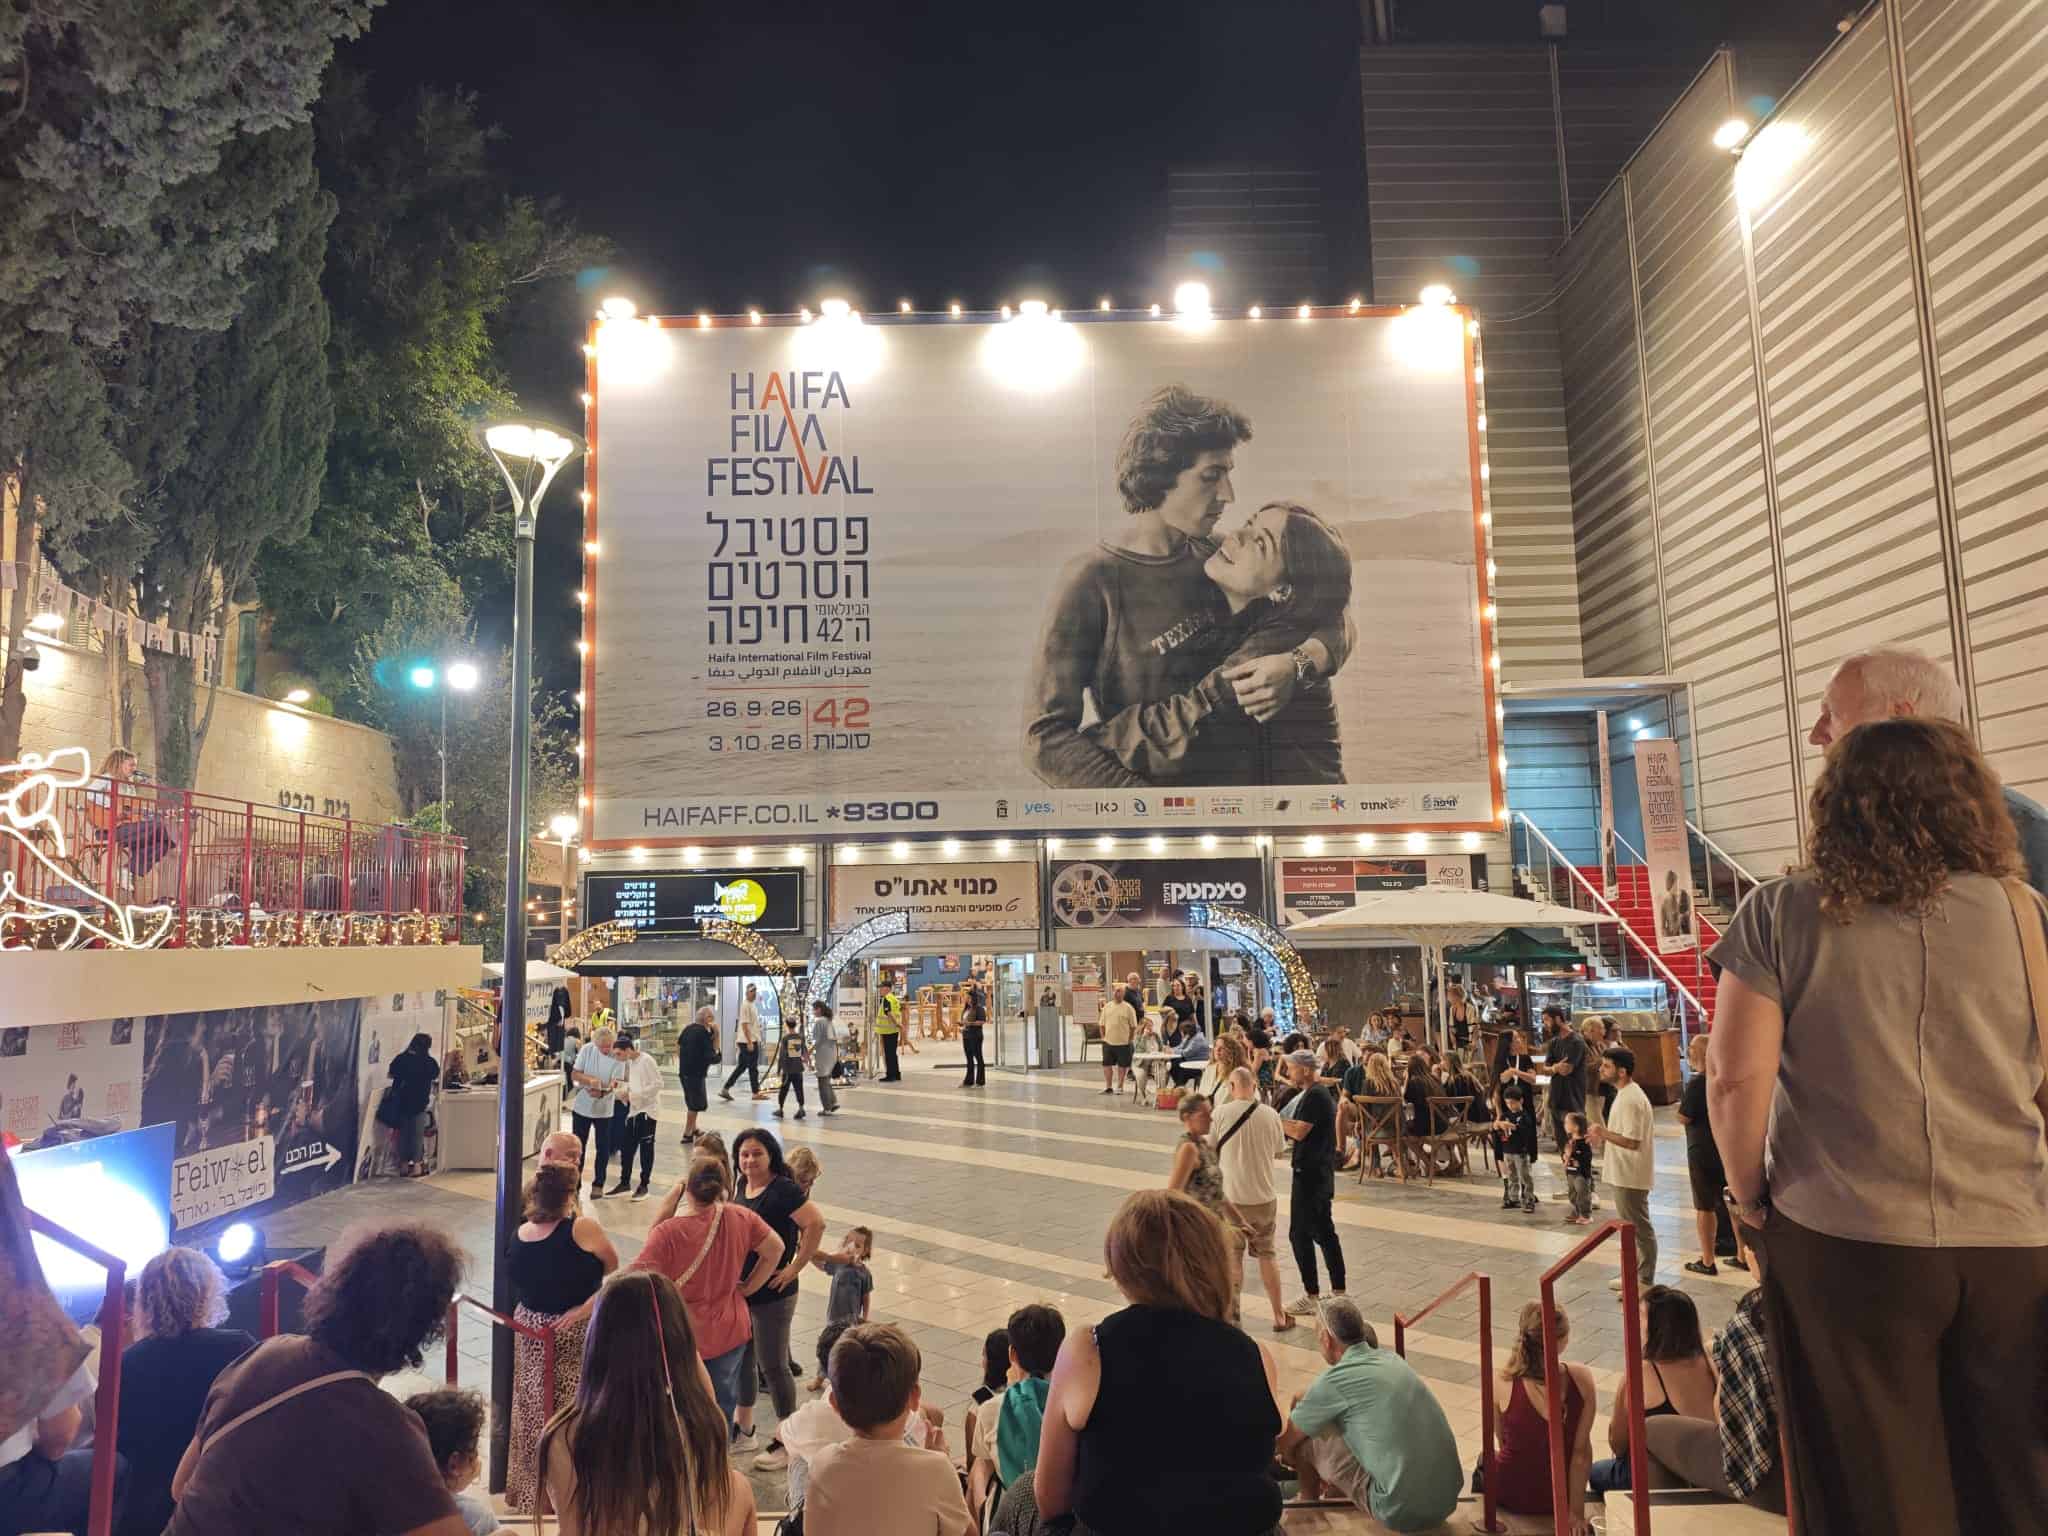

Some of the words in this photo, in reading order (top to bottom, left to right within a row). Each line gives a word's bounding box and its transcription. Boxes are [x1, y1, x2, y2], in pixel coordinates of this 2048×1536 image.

[731, 371, 850, 410] HAIFA
[731, 414, 828, 453] FILM
[707, 456, 874, 496] FESTIVAL
[706, 511, 869, 558] פסטיבל
[708, 560, 869, 601] הסרטים
[815, 601, 870, 617] הבינלאומי
[707, 604, 808, 645] חיפה
[708, 652, 736, 664] Haifa
[738, 651, 804, 663] International
[806, 651, 829, 662] Film
[832, 650, 872, 661] Festival
[706, 700, 802, 718] 26.9.26
[812, 697, 871, 729] 42
[708, 734, 802, 752] 3.10.26
[812, 732, 871, 751] סוכות
[643, 804, 819, 827] HAIFAFF.CO.IL
[953, 877, 998, 896] מנוי
